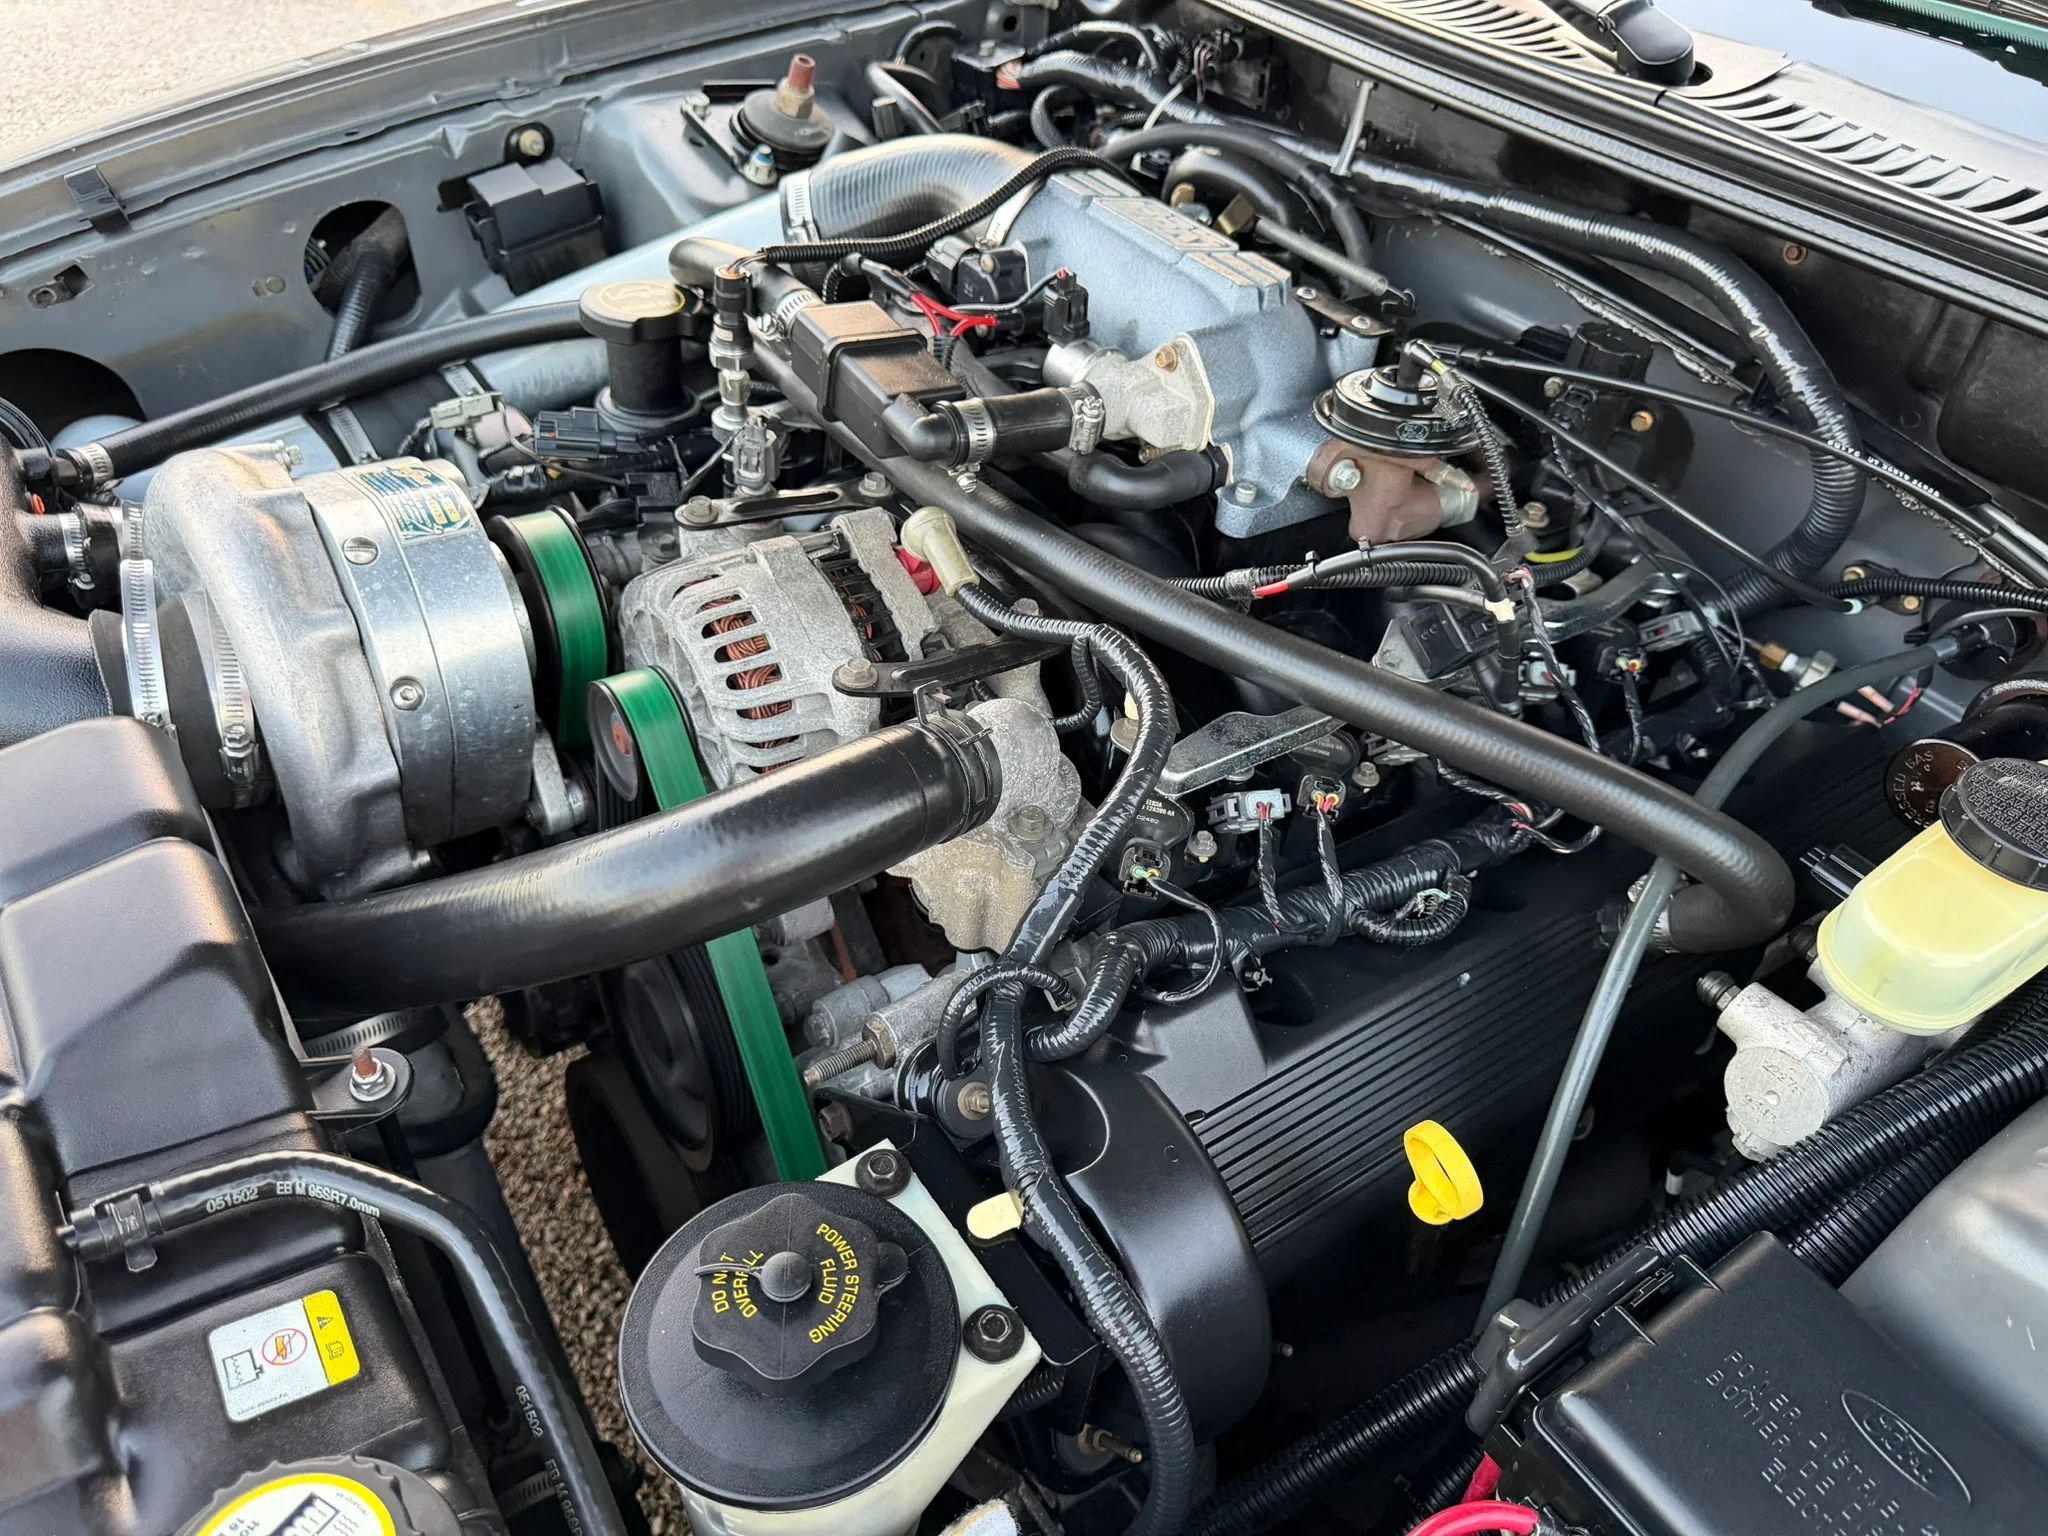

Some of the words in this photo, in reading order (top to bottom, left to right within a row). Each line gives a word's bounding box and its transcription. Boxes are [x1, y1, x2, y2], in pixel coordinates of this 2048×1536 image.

[1905, 750, 1934, 769] GAS
[1990, 760, 2014, 777] FLUID
[1968, 794, 1990, 807] DOT
[2007, 797, 2037, 816] AVANT
[2016, 792, 2031, 803] LE
[2028, 799, 2048, 816] BOU
[206, 1186, 260, 1215] 051502
[276, 1182, 292, 1195] EB
[296, 1181, 306, 1196] M
[816, 1222, 859, 1271] POWER
[712, 1251, 735, 1285] NT
[733, 1249, 764, 1319] OVERFLL
[818, 1258, 838, 1305] FLUID
[711, 1288, 730, 1314] DO
[808, 1273, 861, 1344] STEERING
[515, 1385, 544, 1438] 051502
[544, 1457, 561, 1480] EB
[555, 1482, 569, 1500] M
[1800, 1460, 1836, 1495] DE
